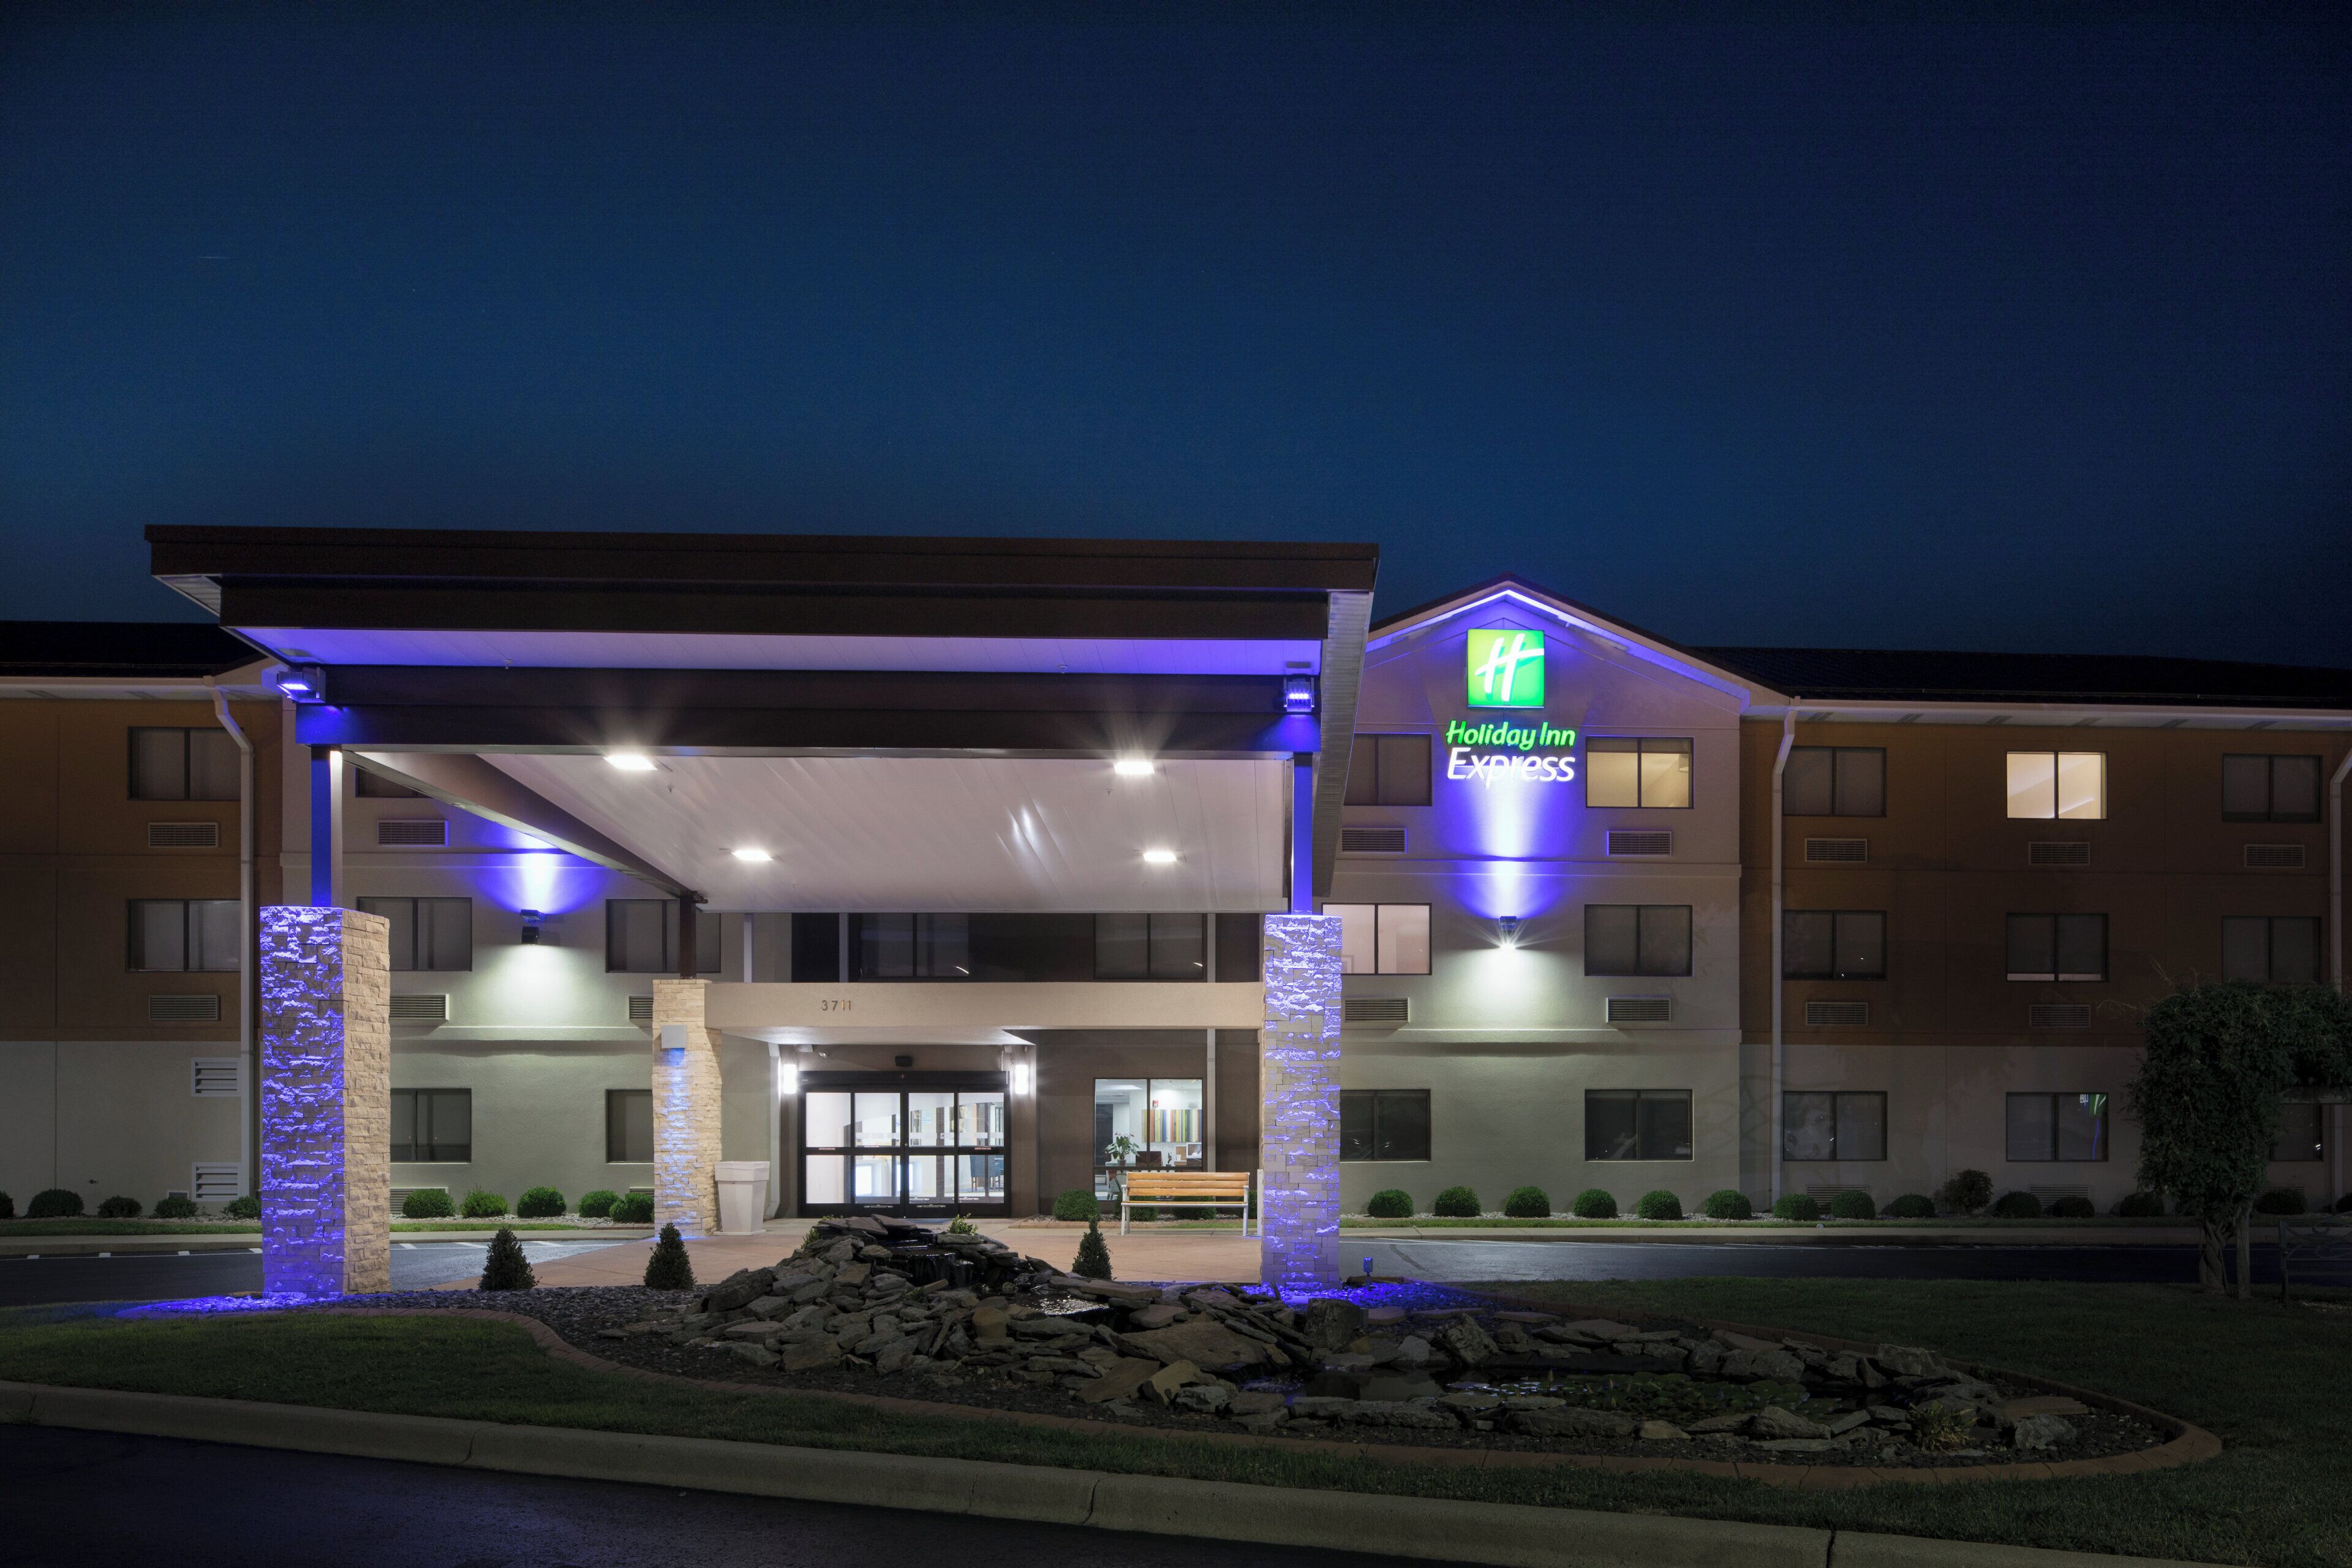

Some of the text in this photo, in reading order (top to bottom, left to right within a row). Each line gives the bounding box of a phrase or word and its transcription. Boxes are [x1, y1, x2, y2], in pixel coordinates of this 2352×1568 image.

[1446, 720, 1576, 751] Holiday Inn
[1447, 747, 1576, 790] Express
[821, 999, 851, 1011] 3711
